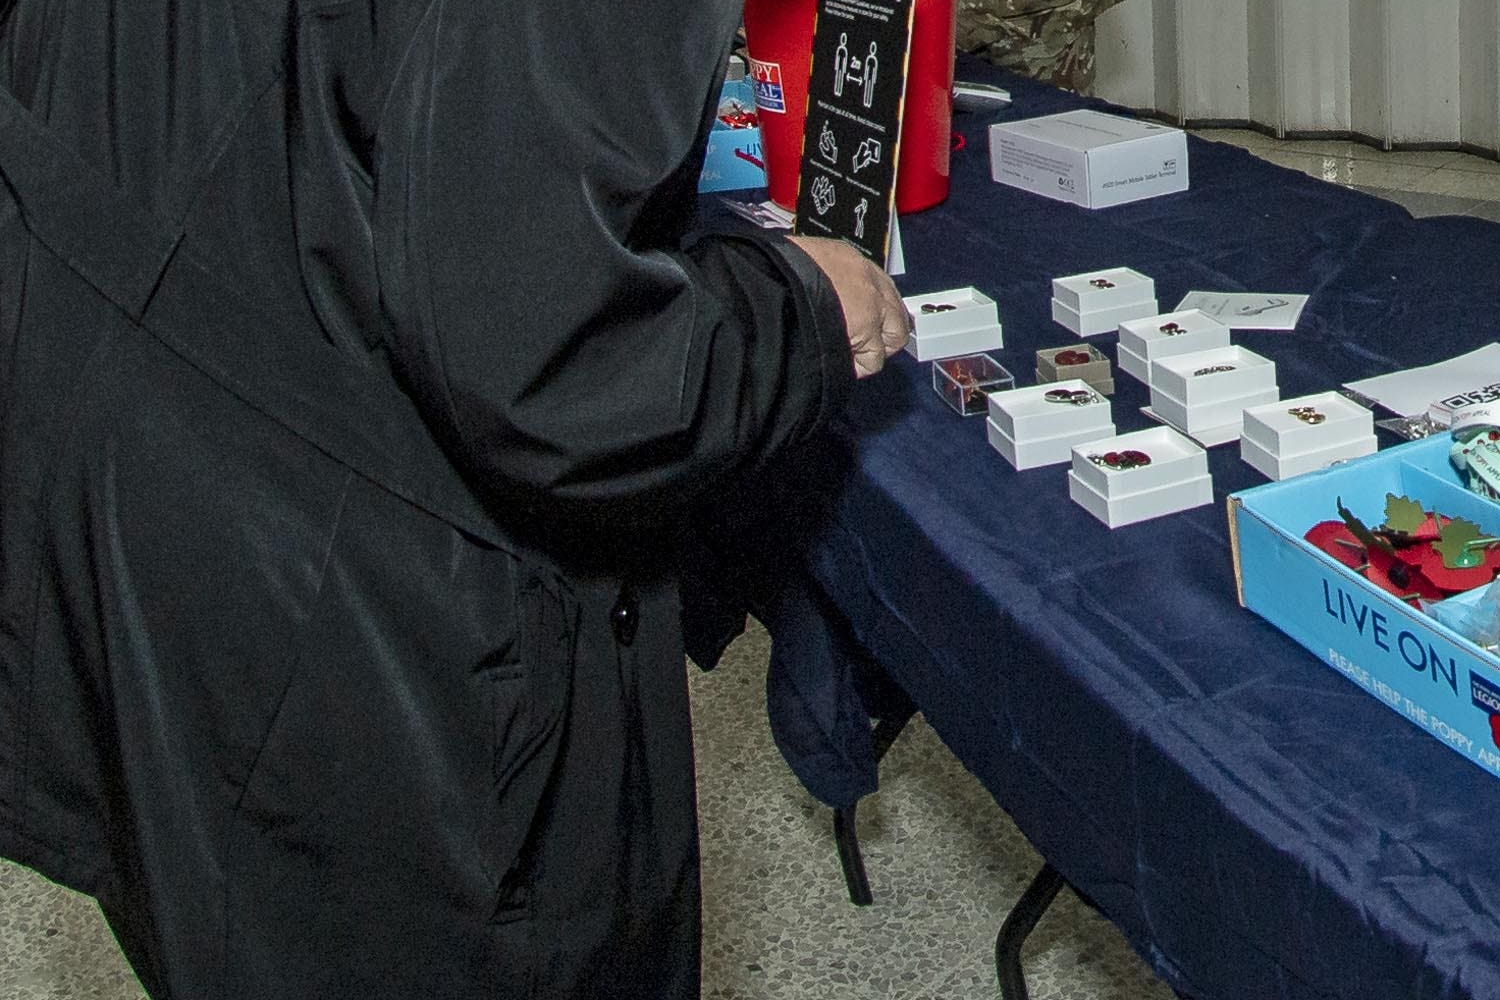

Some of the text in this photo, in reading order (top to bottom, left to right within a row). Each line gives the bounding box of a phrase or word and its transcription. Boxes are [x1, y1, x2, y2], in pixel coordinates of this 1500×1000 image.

[1322, 578, 1459, 697] LIVE ON
[1328, 647, 1372, 687] PLEASE
[1373, 677, 1401, 708] HELP
[1403, 697, 1428, 725] THE
[1431, 716, 1473, 752] POPPY
